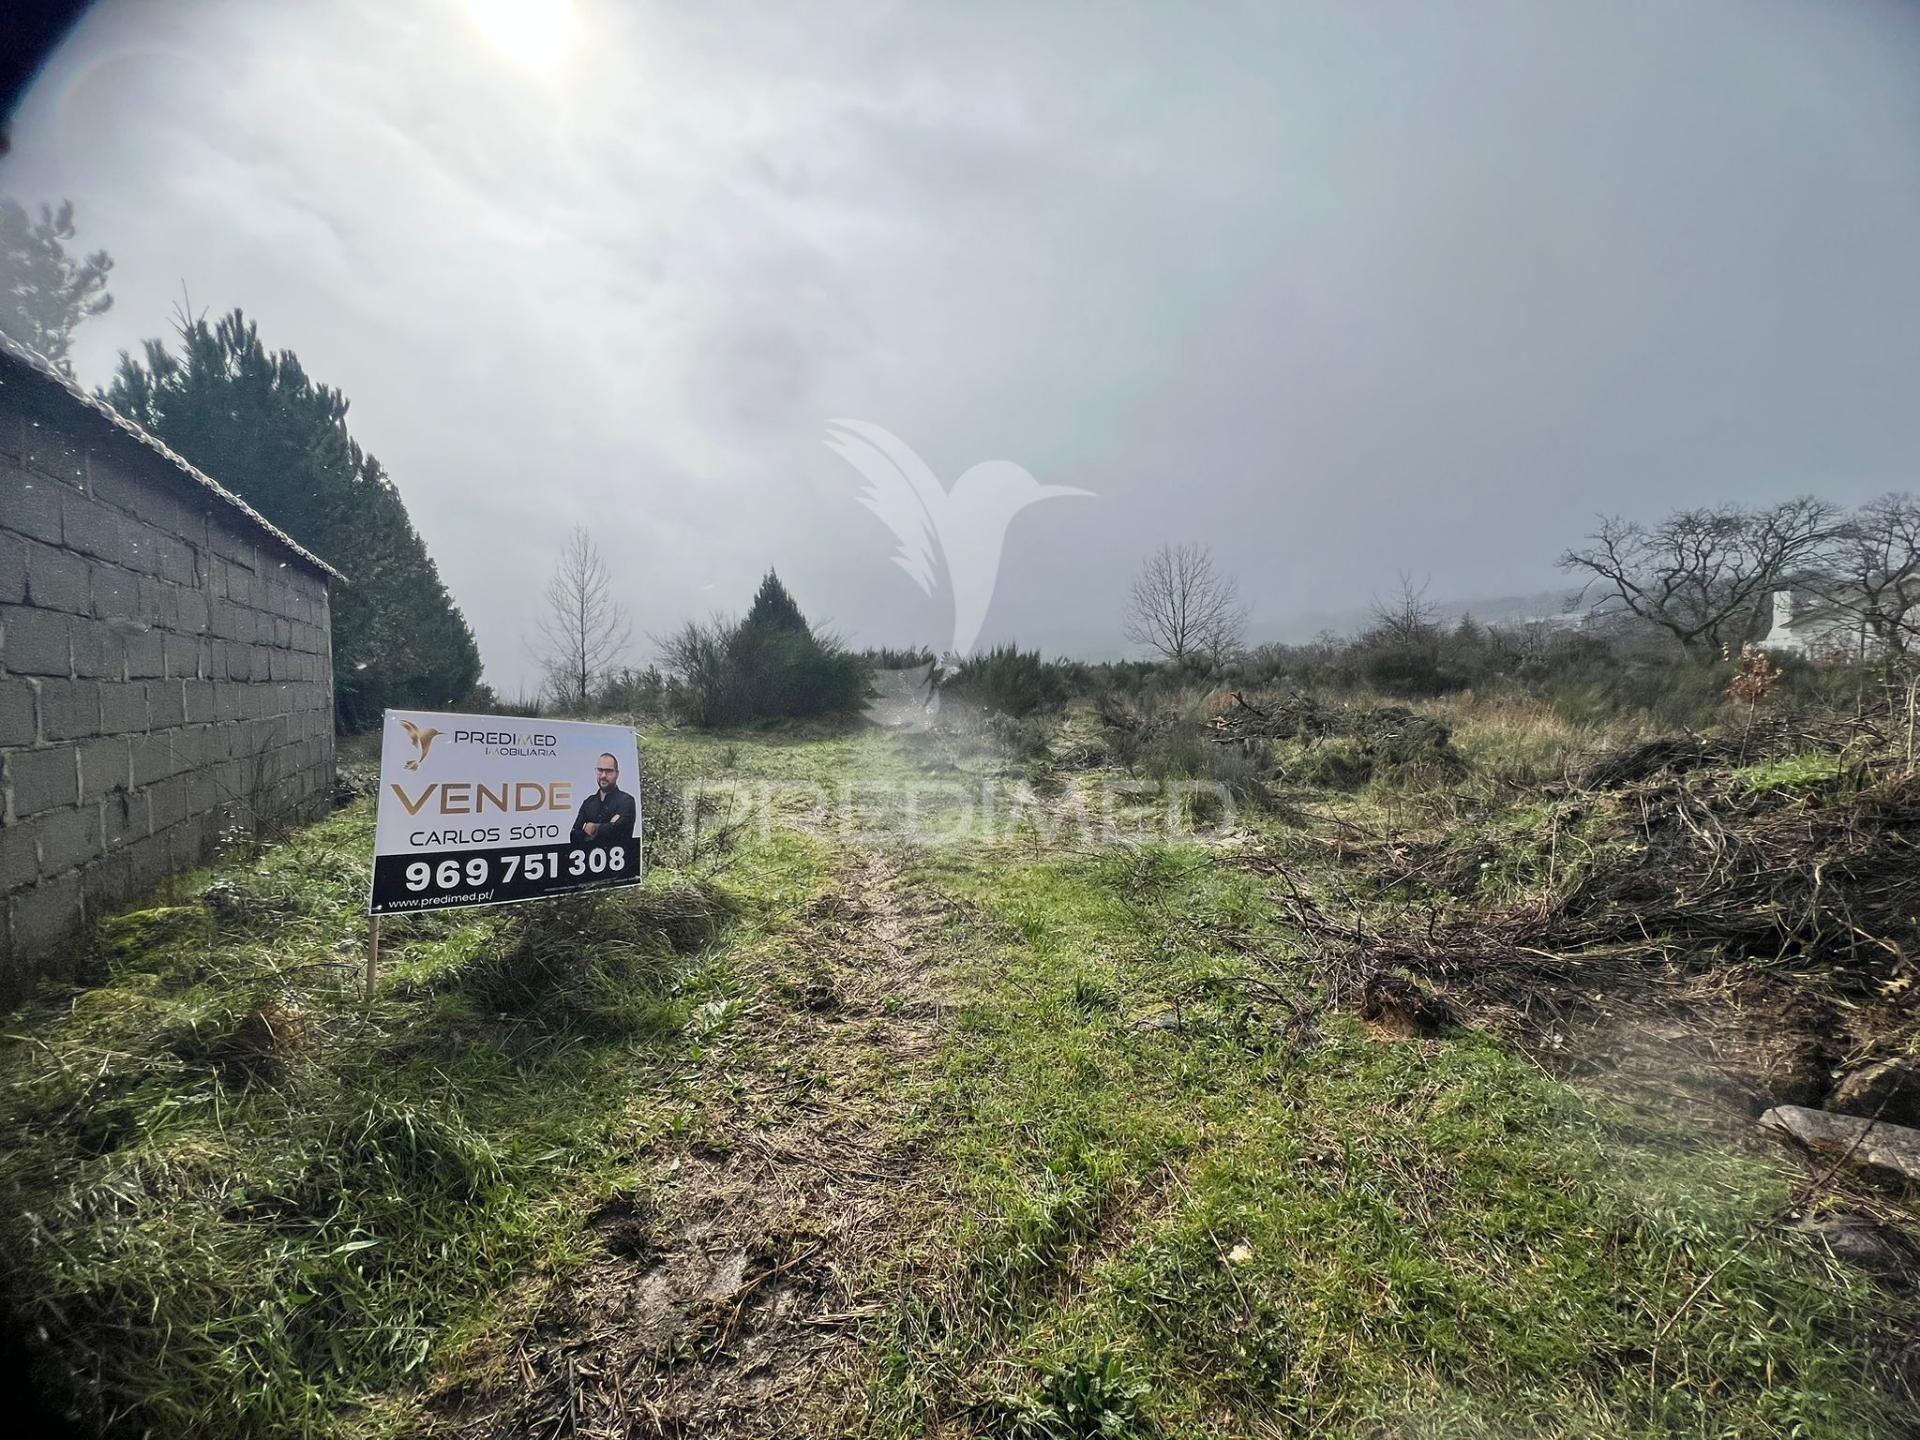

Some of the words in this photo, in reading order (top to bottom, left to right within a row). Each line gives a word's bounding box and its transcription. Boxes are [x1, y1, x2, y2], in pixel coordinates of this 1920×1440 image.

[454, 731, 557, 747] PREDIMED
[391, 782, 573, 816] VENDE
[409, 829, 500, 846] CARLOS
[405, 858, 489, 892] 969
[500, 852, 558, 884] 751
[568, 846, 625, 876] 308
[388, 889, 495, 909] www.predimed.pt/
